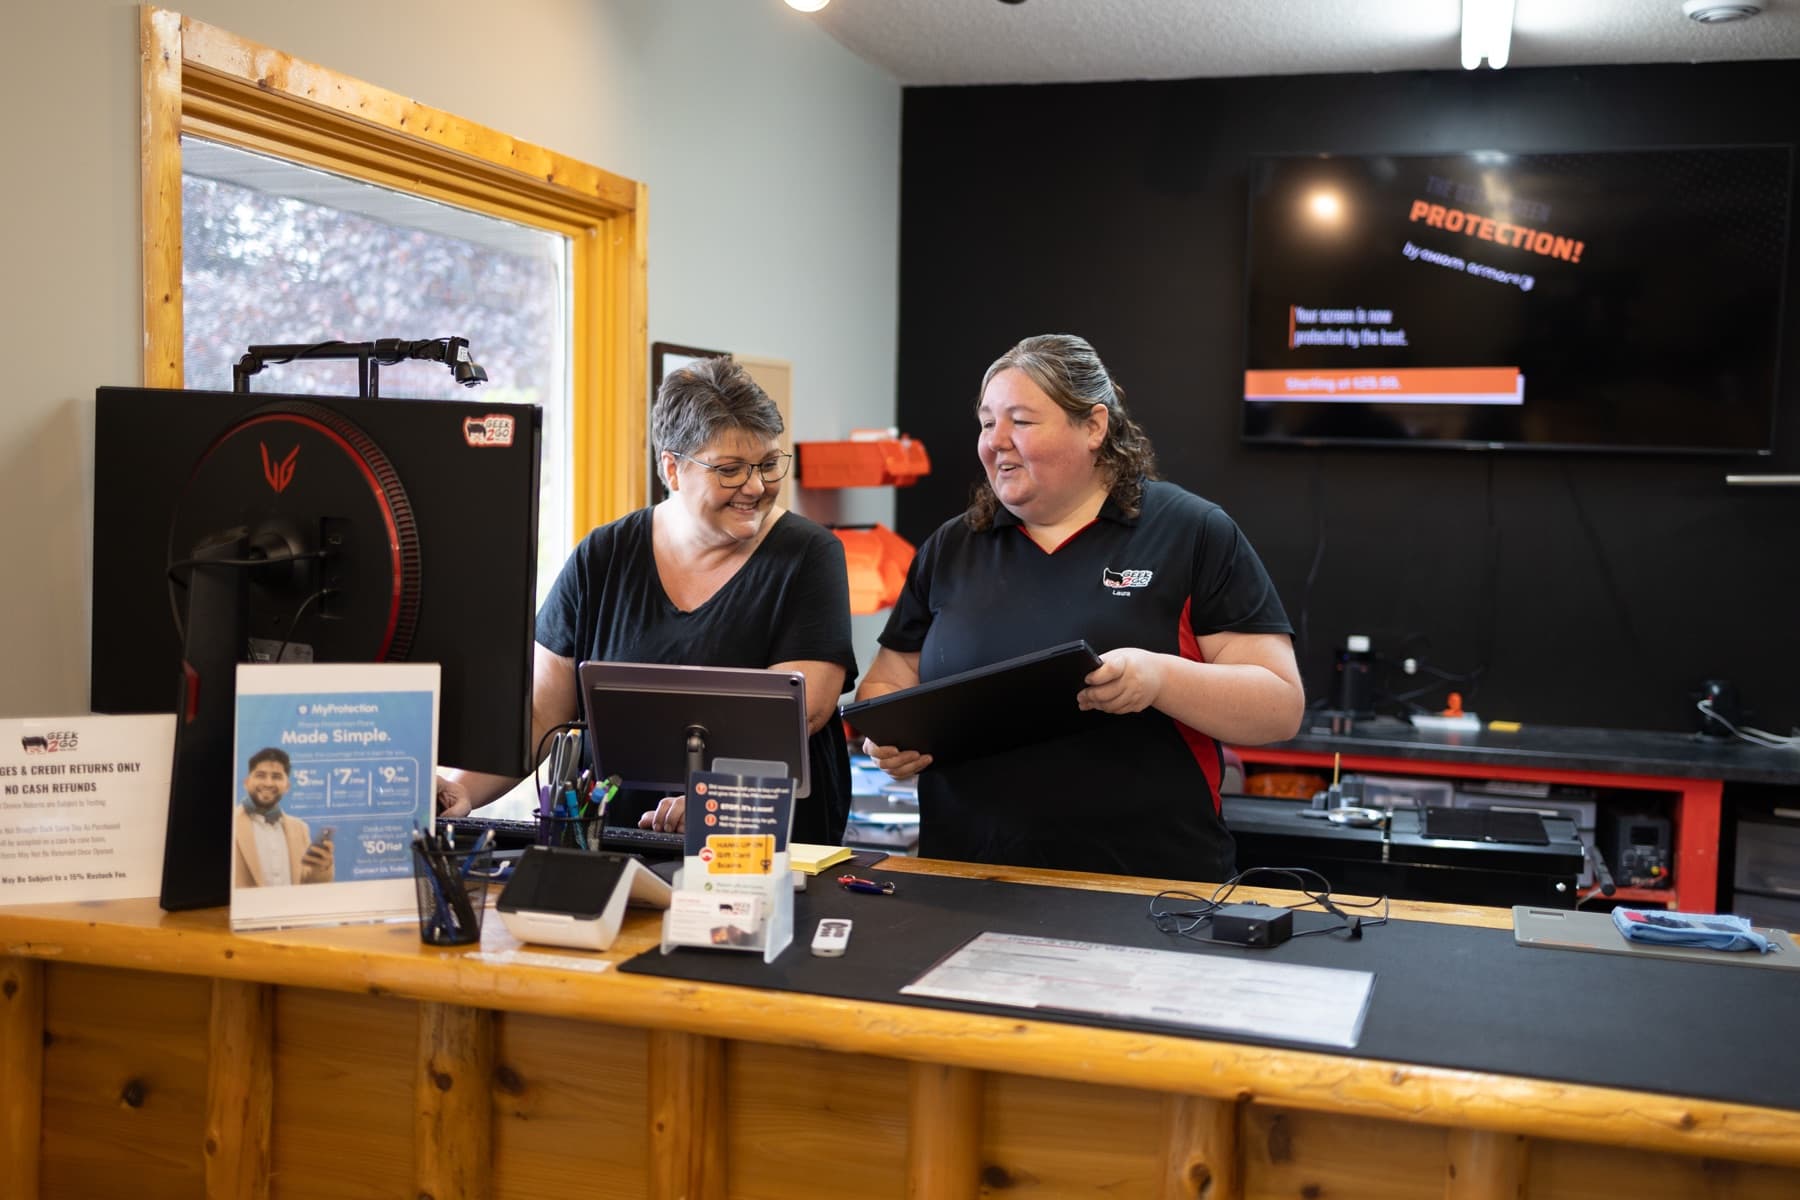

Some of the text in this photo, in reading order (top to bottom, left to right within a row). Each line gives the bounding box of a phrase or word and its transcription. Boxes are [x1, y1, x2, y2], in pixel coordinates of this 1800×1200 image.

[1409, 200, 1585, 264] PROTECTION!
[1403, 241, 1420, 261] by
[486, 420, 510, 429] GEEK
[1123, 570, 1152, 578] GEEK
[311, 703, 378, 717] MyProtection
[47, 731, 78, 740] GEEK
[281, 727, 392, 746] Made Simple.
[21, 765, 27, 776] &
[31, 764, 66, 776] CREDIT
[70, 763, 114, 774] RETURNS
[117, 762, 140, 773] ONLY
[5, 781, 97, 795] NO CASH REFUNDS
